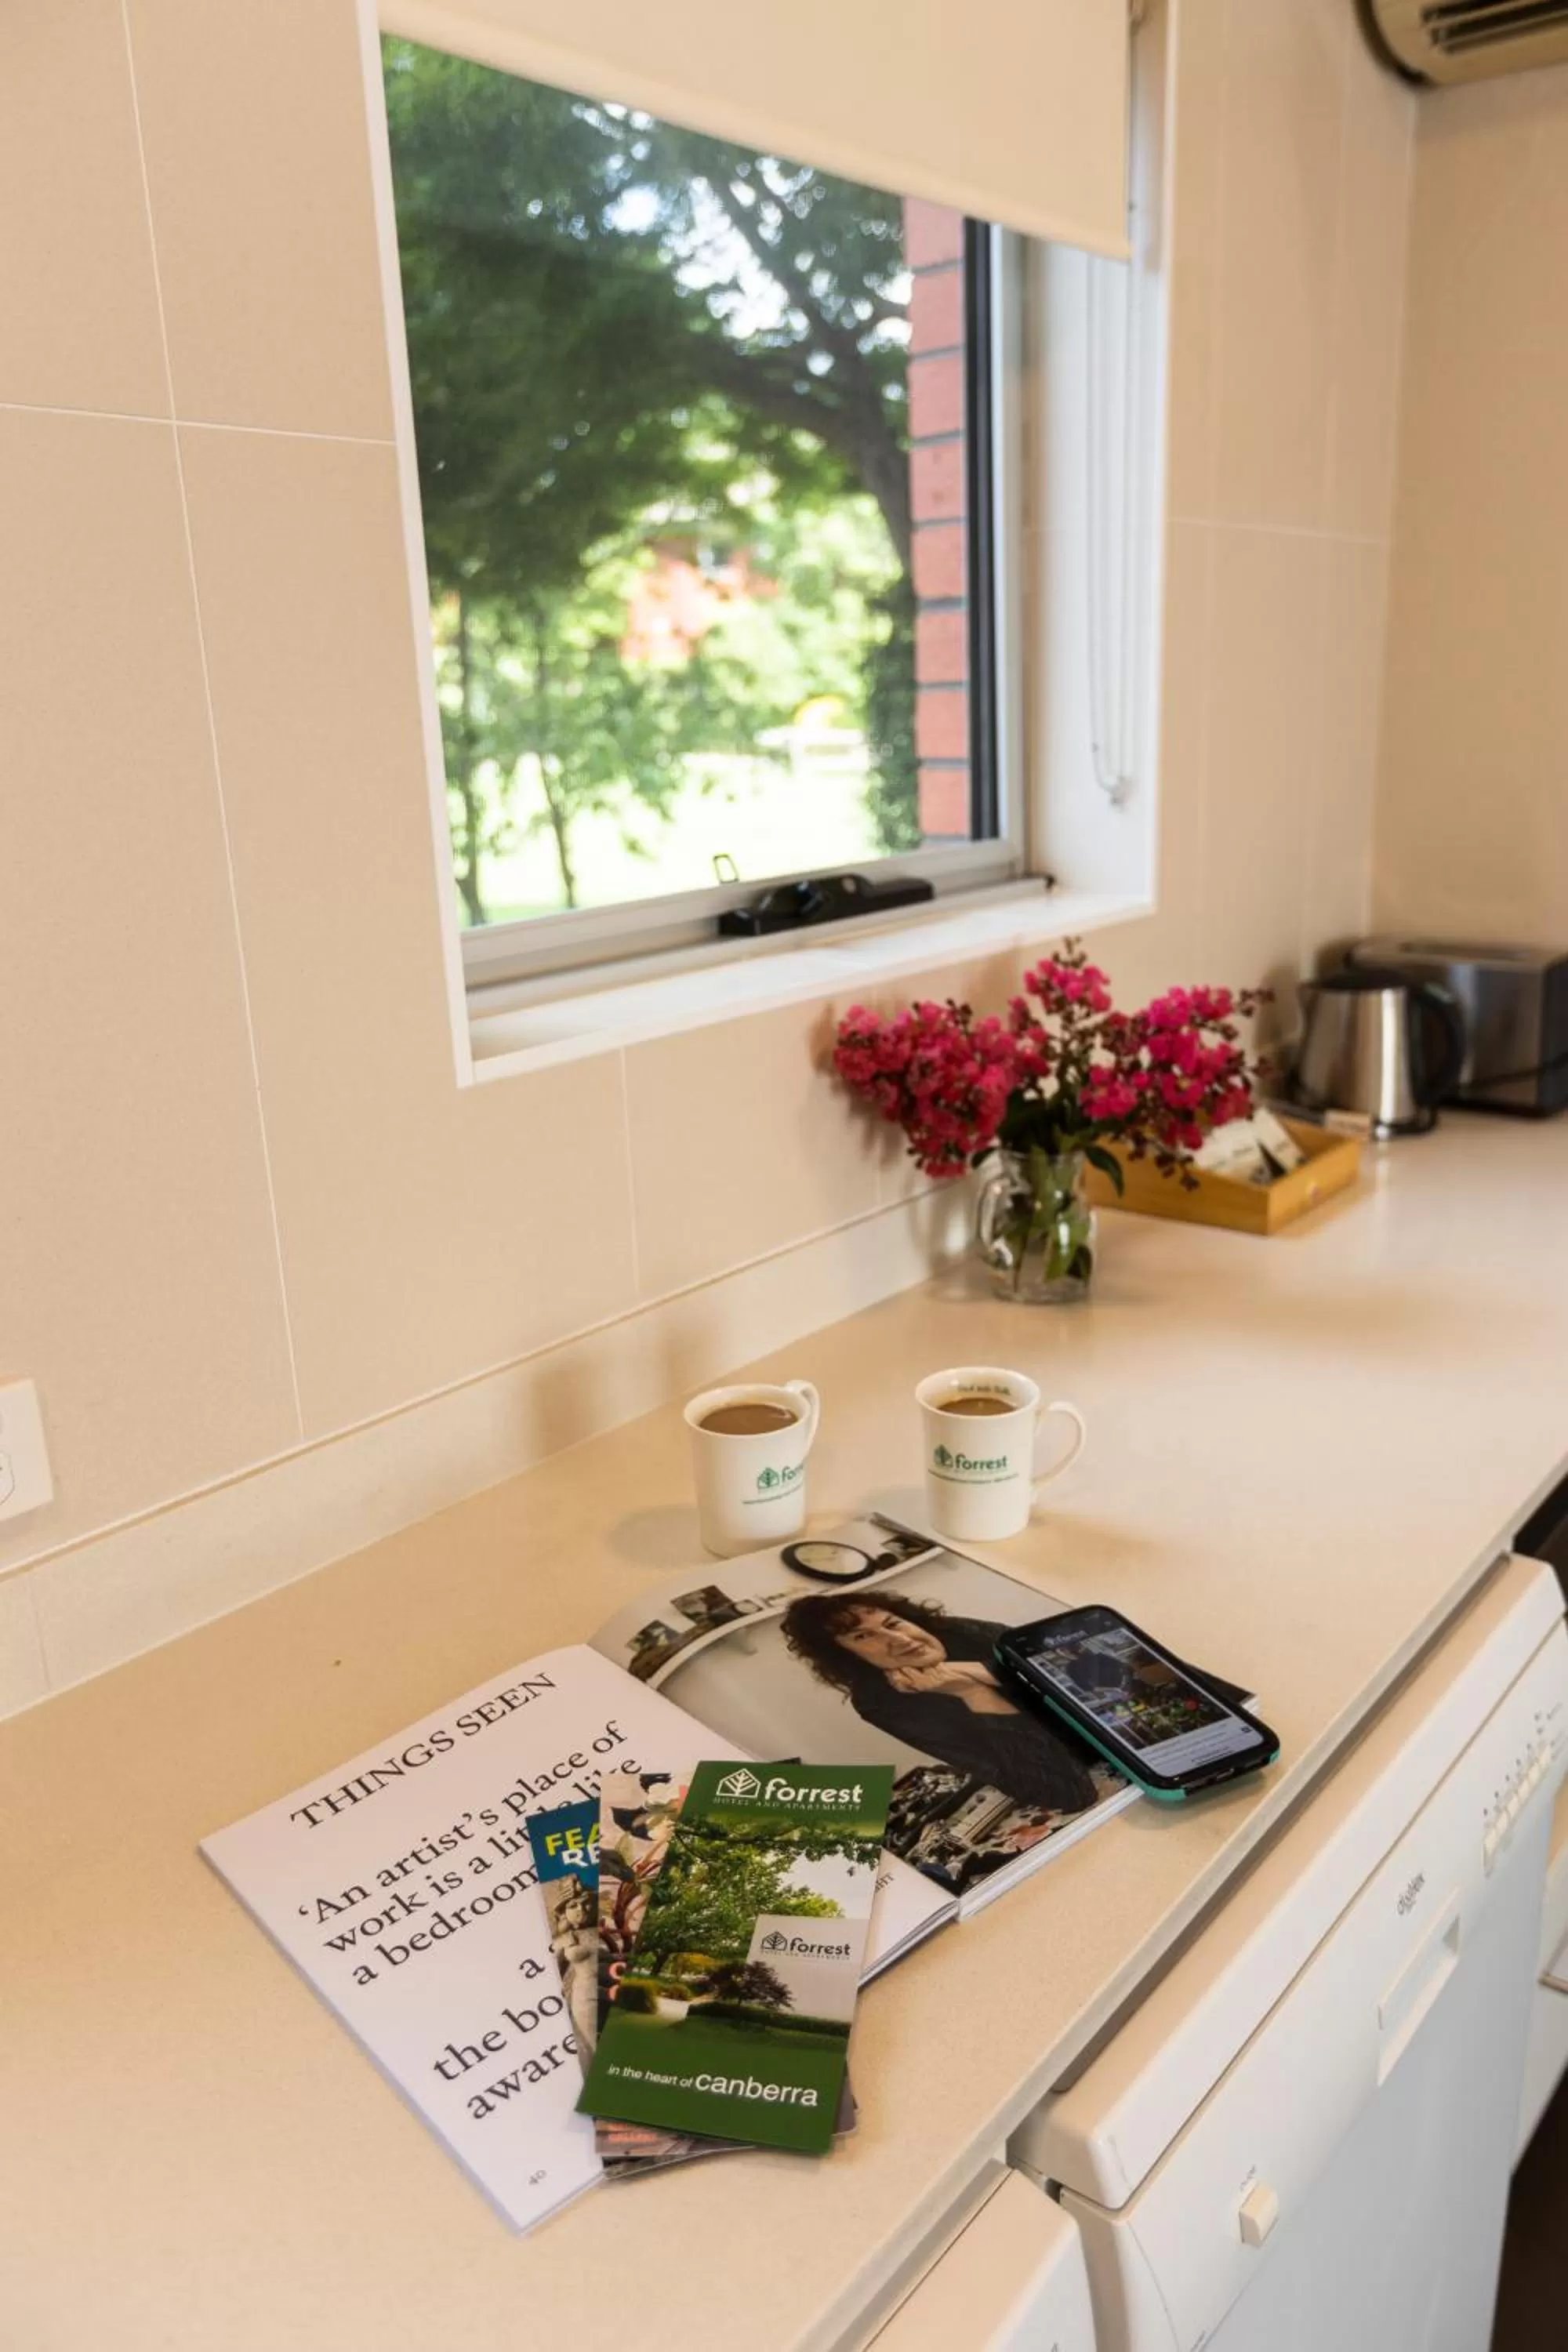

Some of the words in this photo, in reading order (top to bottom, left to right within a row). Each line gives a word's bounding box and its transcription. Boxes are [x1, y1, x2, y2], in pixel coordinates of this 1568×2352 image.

[954, 1453, 1007, 1470] forrest
[289, 1730, 456, 1829] THINGS
[456, 1672, 556, 1737] SEEN
[764, 1777, 863, 1803] forrest
[376, 1809, 500, 1888] artist’s
[501, 1752, 590, 1817] place
[592, 1719, 628, 1754] of
[322, 1892, 429, 1952] work
[425, 1871, 463, 1898] is
[468, 1856, 493, 1875] a
[572, 1759, 642, 1801] lie
[562, 1842, 601, 1868] RE
[789, 1937, 851, 1956] forrest
[352, 1965, 379, 1986] a
[518, 1958, 546, 1980] a
[433, 2031, 507, 2081] the
[501, 1995, 564, 2034] bo
[608, 2063, 620, 2076] in
[622, 2066, 643, 2079] the
[644, 2070, 678, 2085] heart
[679, 2076, 695, 2088] of
[695, 2073, 819, 2107] canberra
